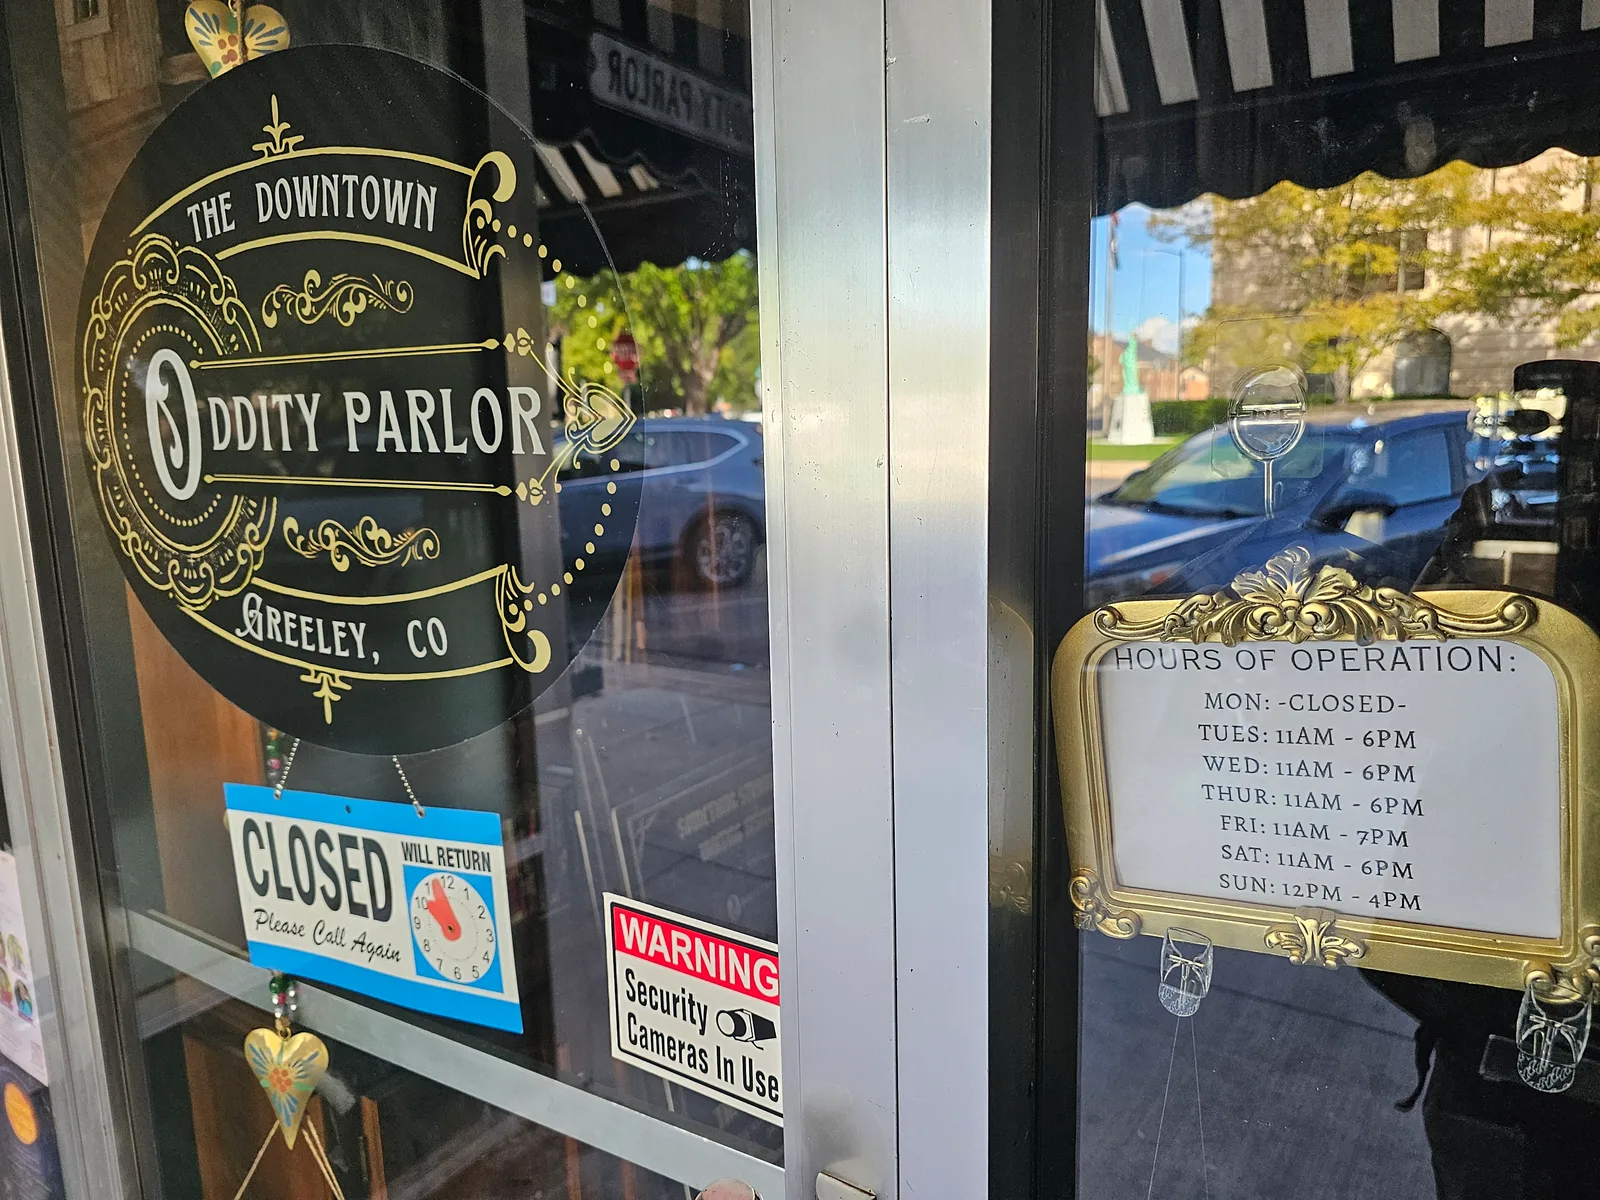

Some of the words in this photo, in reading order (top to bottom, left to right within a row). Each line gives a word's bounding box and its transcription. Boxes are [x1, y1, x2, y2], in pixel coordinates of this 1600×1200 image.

[187, 191, 236, 242] THE
[255, 174, 438, 232] DOWNTOWN
[146, 348, 321, 501] ODDITY
[343, 386, 547, 455] PARLOR
[235, 592, 381, 666] GREELEY,
[407, 617, 449, 659] CO
[1114, 647, 1222, 671] HOURS
[1235, 647, 1277, 672] OF
[1290, 645, 1517, 673] OPERATION:
[1204, 692, 1270, 711] MON:
[1278, 693, 1407, 714] -CLOSED-
[1198, 724, 1269, 743] TUES:
[1276, 727, 1335, 746] 11AM
[1362, 729, 1417, 749] 6PM
[1202, 755, 1268, 775] WED:
[1275, 759, 1335, 779] 11AM
[1362, 764, 1416, 783] 6PM
[1201, 784, 1277, 806] THUR:
[1283, 793, 1342, 812] 11AM
[1370, 797, 1425, 817] 6PM
[1220, 815, 1266, 835] FRI:
[1273, 822, 1331, 841] 11AM
[1356, 829, 1410, 848] 7PM
[242, 817, 394, 923] CLOSED
[401, 841, 434, 867] WILL
[437, 846, 492, 873] RETURN
[1221, 845, 1269, 865] SAT:
[1277, 853, 1335, 872] 11AM
[1361, 860, 1415, 880] 6PM
[440, 875, 455, 890] 12
[463, 887, 470, 901] 1
[1219, 874, 1275, 895] SUN:
[1282, 882, 1342, 902] 12PM
[1368, 892, 1422, 911] 4PM
[415, 896, 429, 910] 10
[477, 905, 486, 919] 2
[253, 908, 306, 937] Please
[312, 919, 347, 948] Call
[350, 931, 401, 963] Again
[413, 916, 421, 930] 9
[486, 928, 494, 943] 3
[423, 938, 431, 952] 8
[482, 950, 490, 964] 4
[618, 912, 780, 999] WARNING
[436, 958, 443, 971] 7
[454, 966, 462, 980] 6
[472, 965, 480, 979] 5
[625, 967, 709, 1036] Security
[627, 1010, 709, 1074] Cameras
[716, 1044, 735, 1086] In
[741, 1055, 780, 1103] Use
